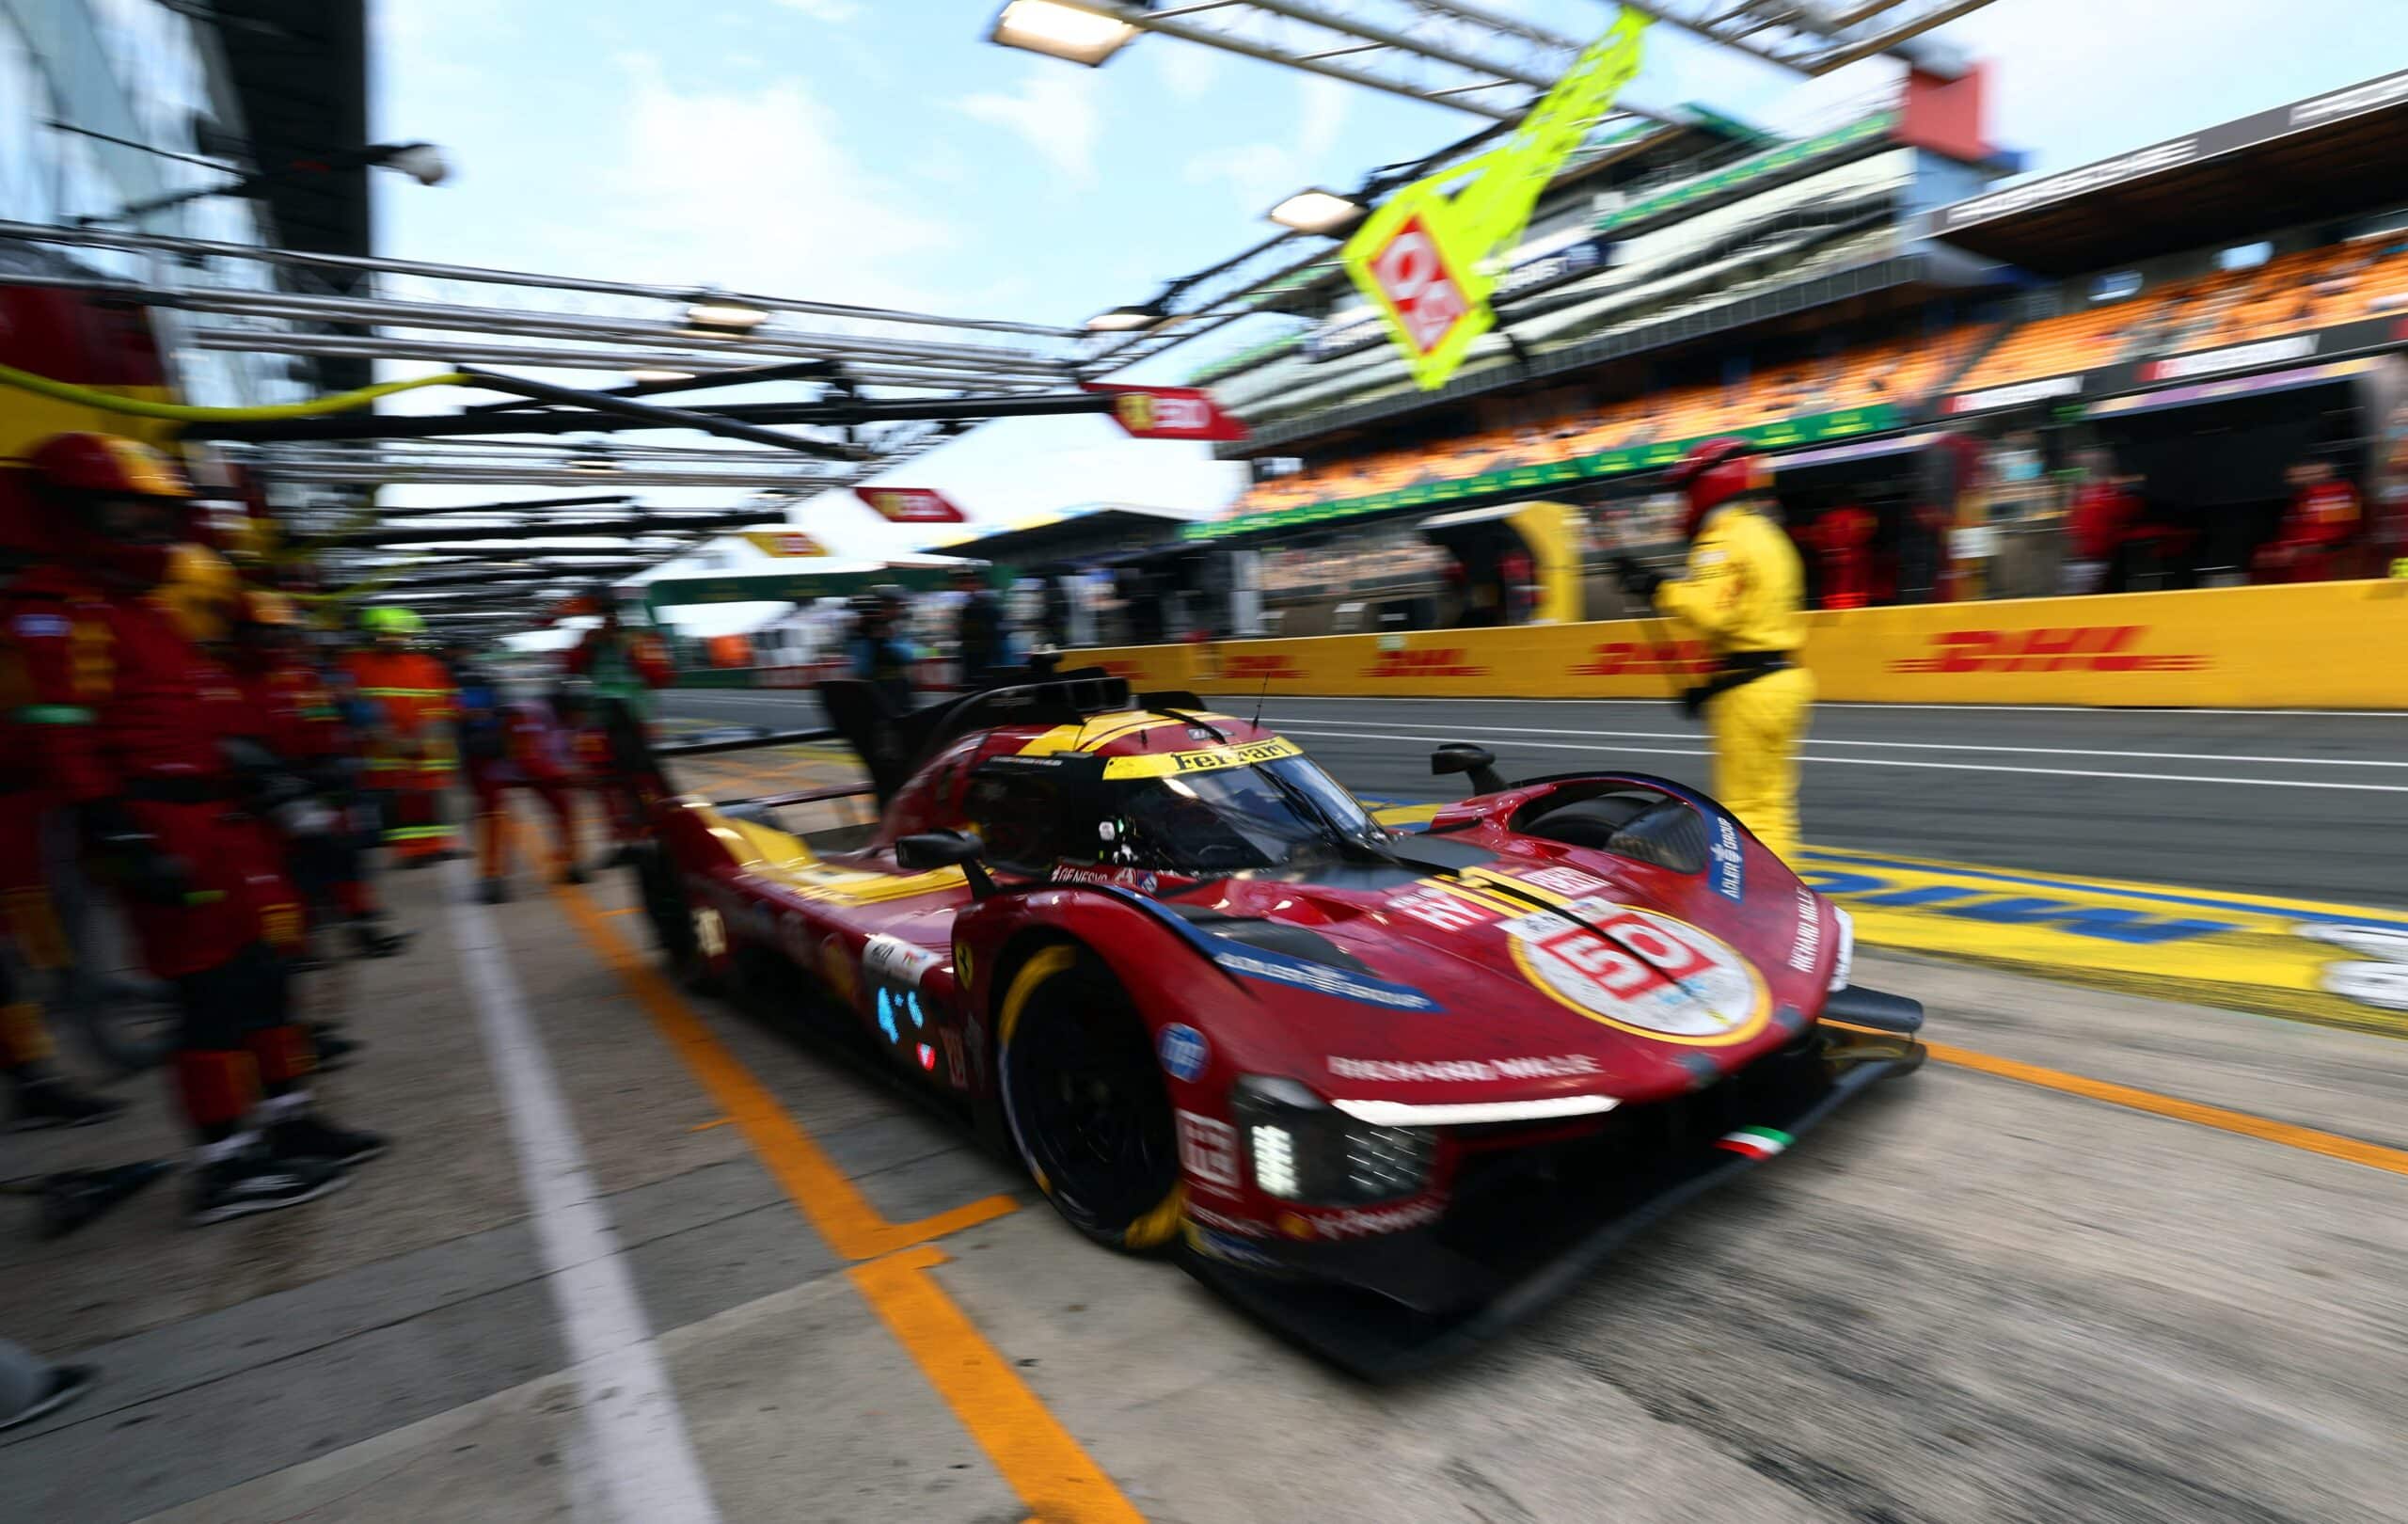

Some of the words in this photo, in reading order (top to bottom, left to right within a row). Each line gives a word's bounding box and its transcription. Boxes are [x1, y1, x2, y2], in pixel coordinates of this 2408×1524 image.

[1924, 625, 2154, 673] DHL
[1717, 817, 1738, 850] GROUP
[1553, 922, 1694, 992] 50
